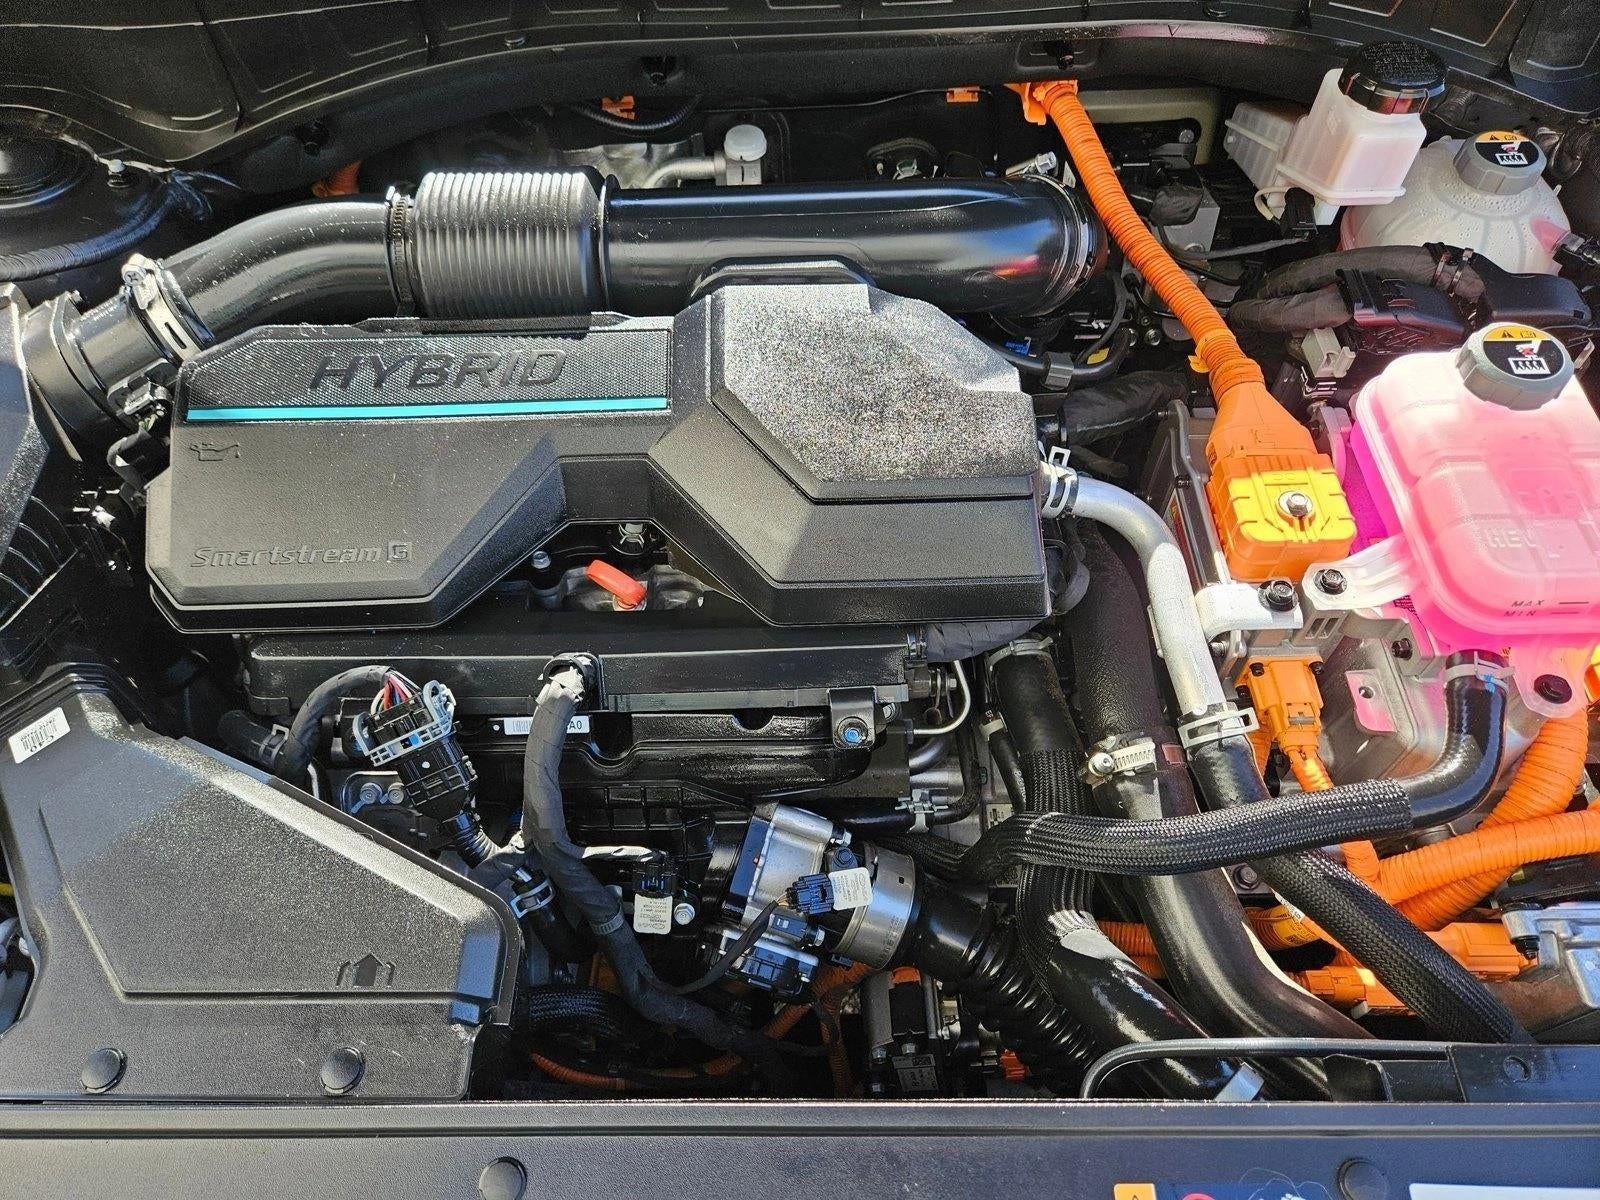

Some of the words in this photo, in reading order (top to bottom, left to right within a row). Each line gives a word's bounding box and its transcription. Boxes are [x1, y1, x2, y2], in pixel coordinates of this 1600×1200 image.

[308, 349, 567, 390] HYBRID
[190, 546, 382, 568] Smartstream
[1511, 599, 1545, 608] MAX
